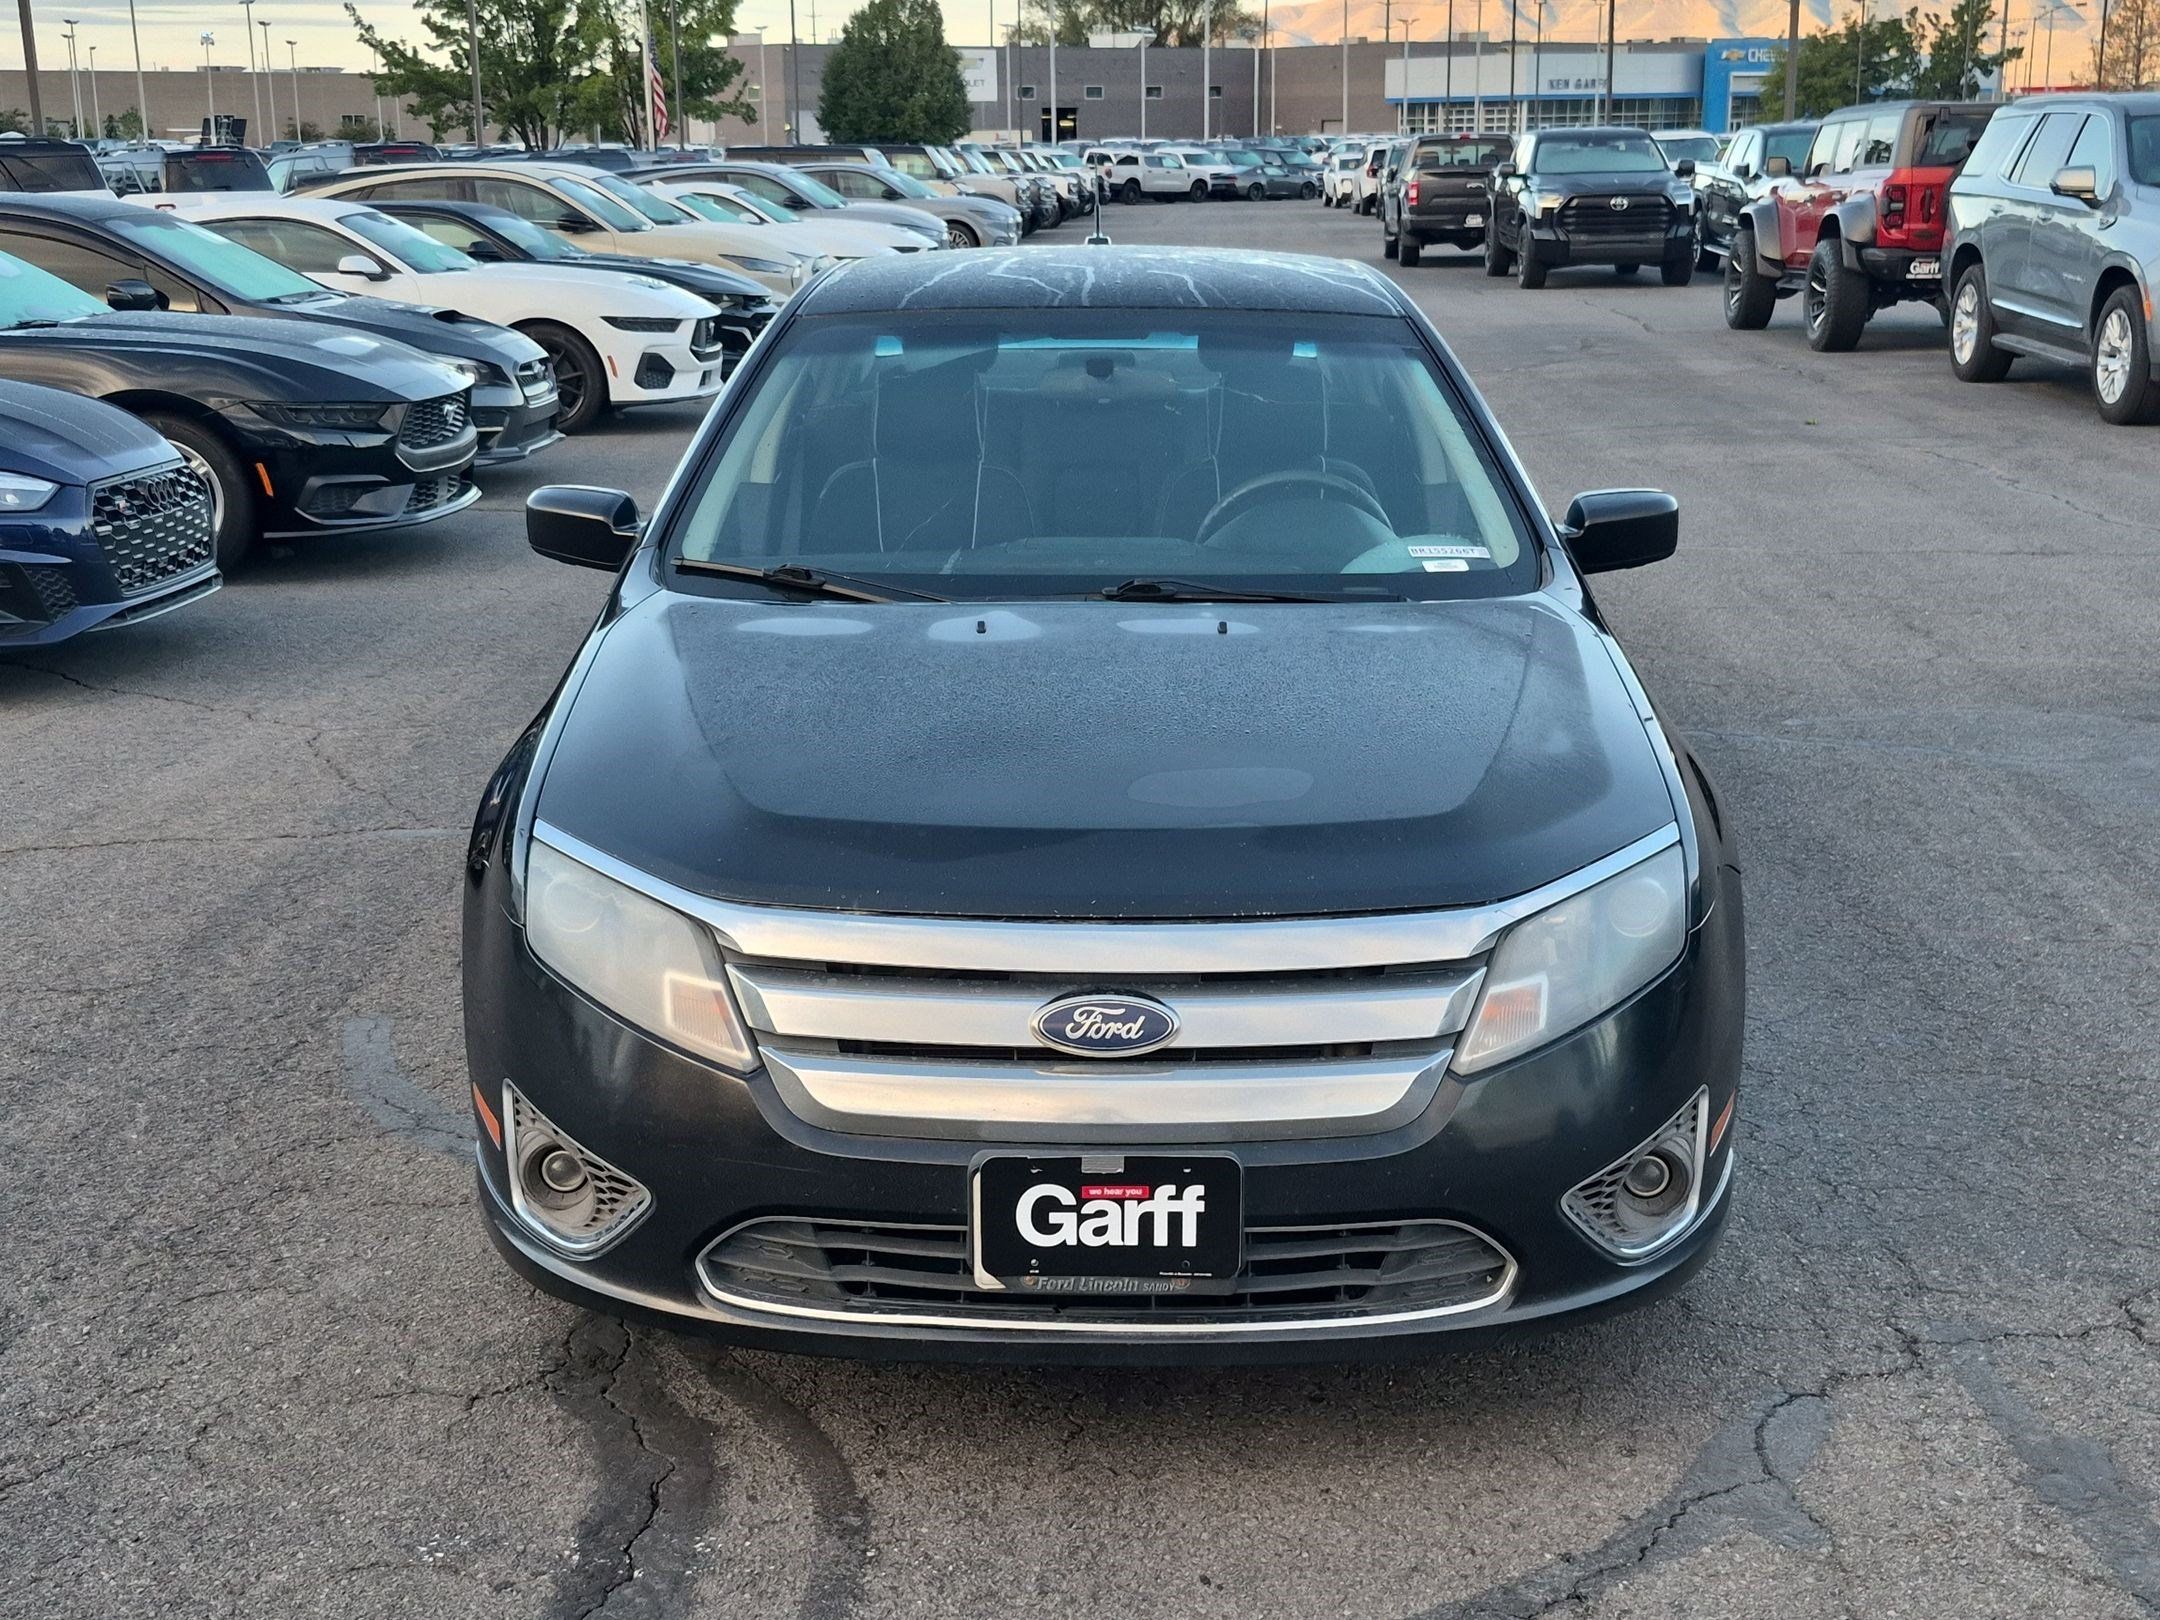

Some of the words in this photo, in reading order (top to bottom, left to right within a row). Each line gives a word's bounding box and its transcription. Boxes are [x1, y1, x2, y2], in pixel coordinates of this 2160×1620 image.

[1549, 79, 1570, 89] KEN
[1065, 1006, 1146, 1040] Ford
[1104, 1186, 1124, 1195] hear
[1125, 1189, 1142, 1197] you
[1015, 1184, 1205, 1247] Garff
[1037, 1276, 1075, 1291] Ford
[1078, 1276, 1139, 1292] Lincoln
